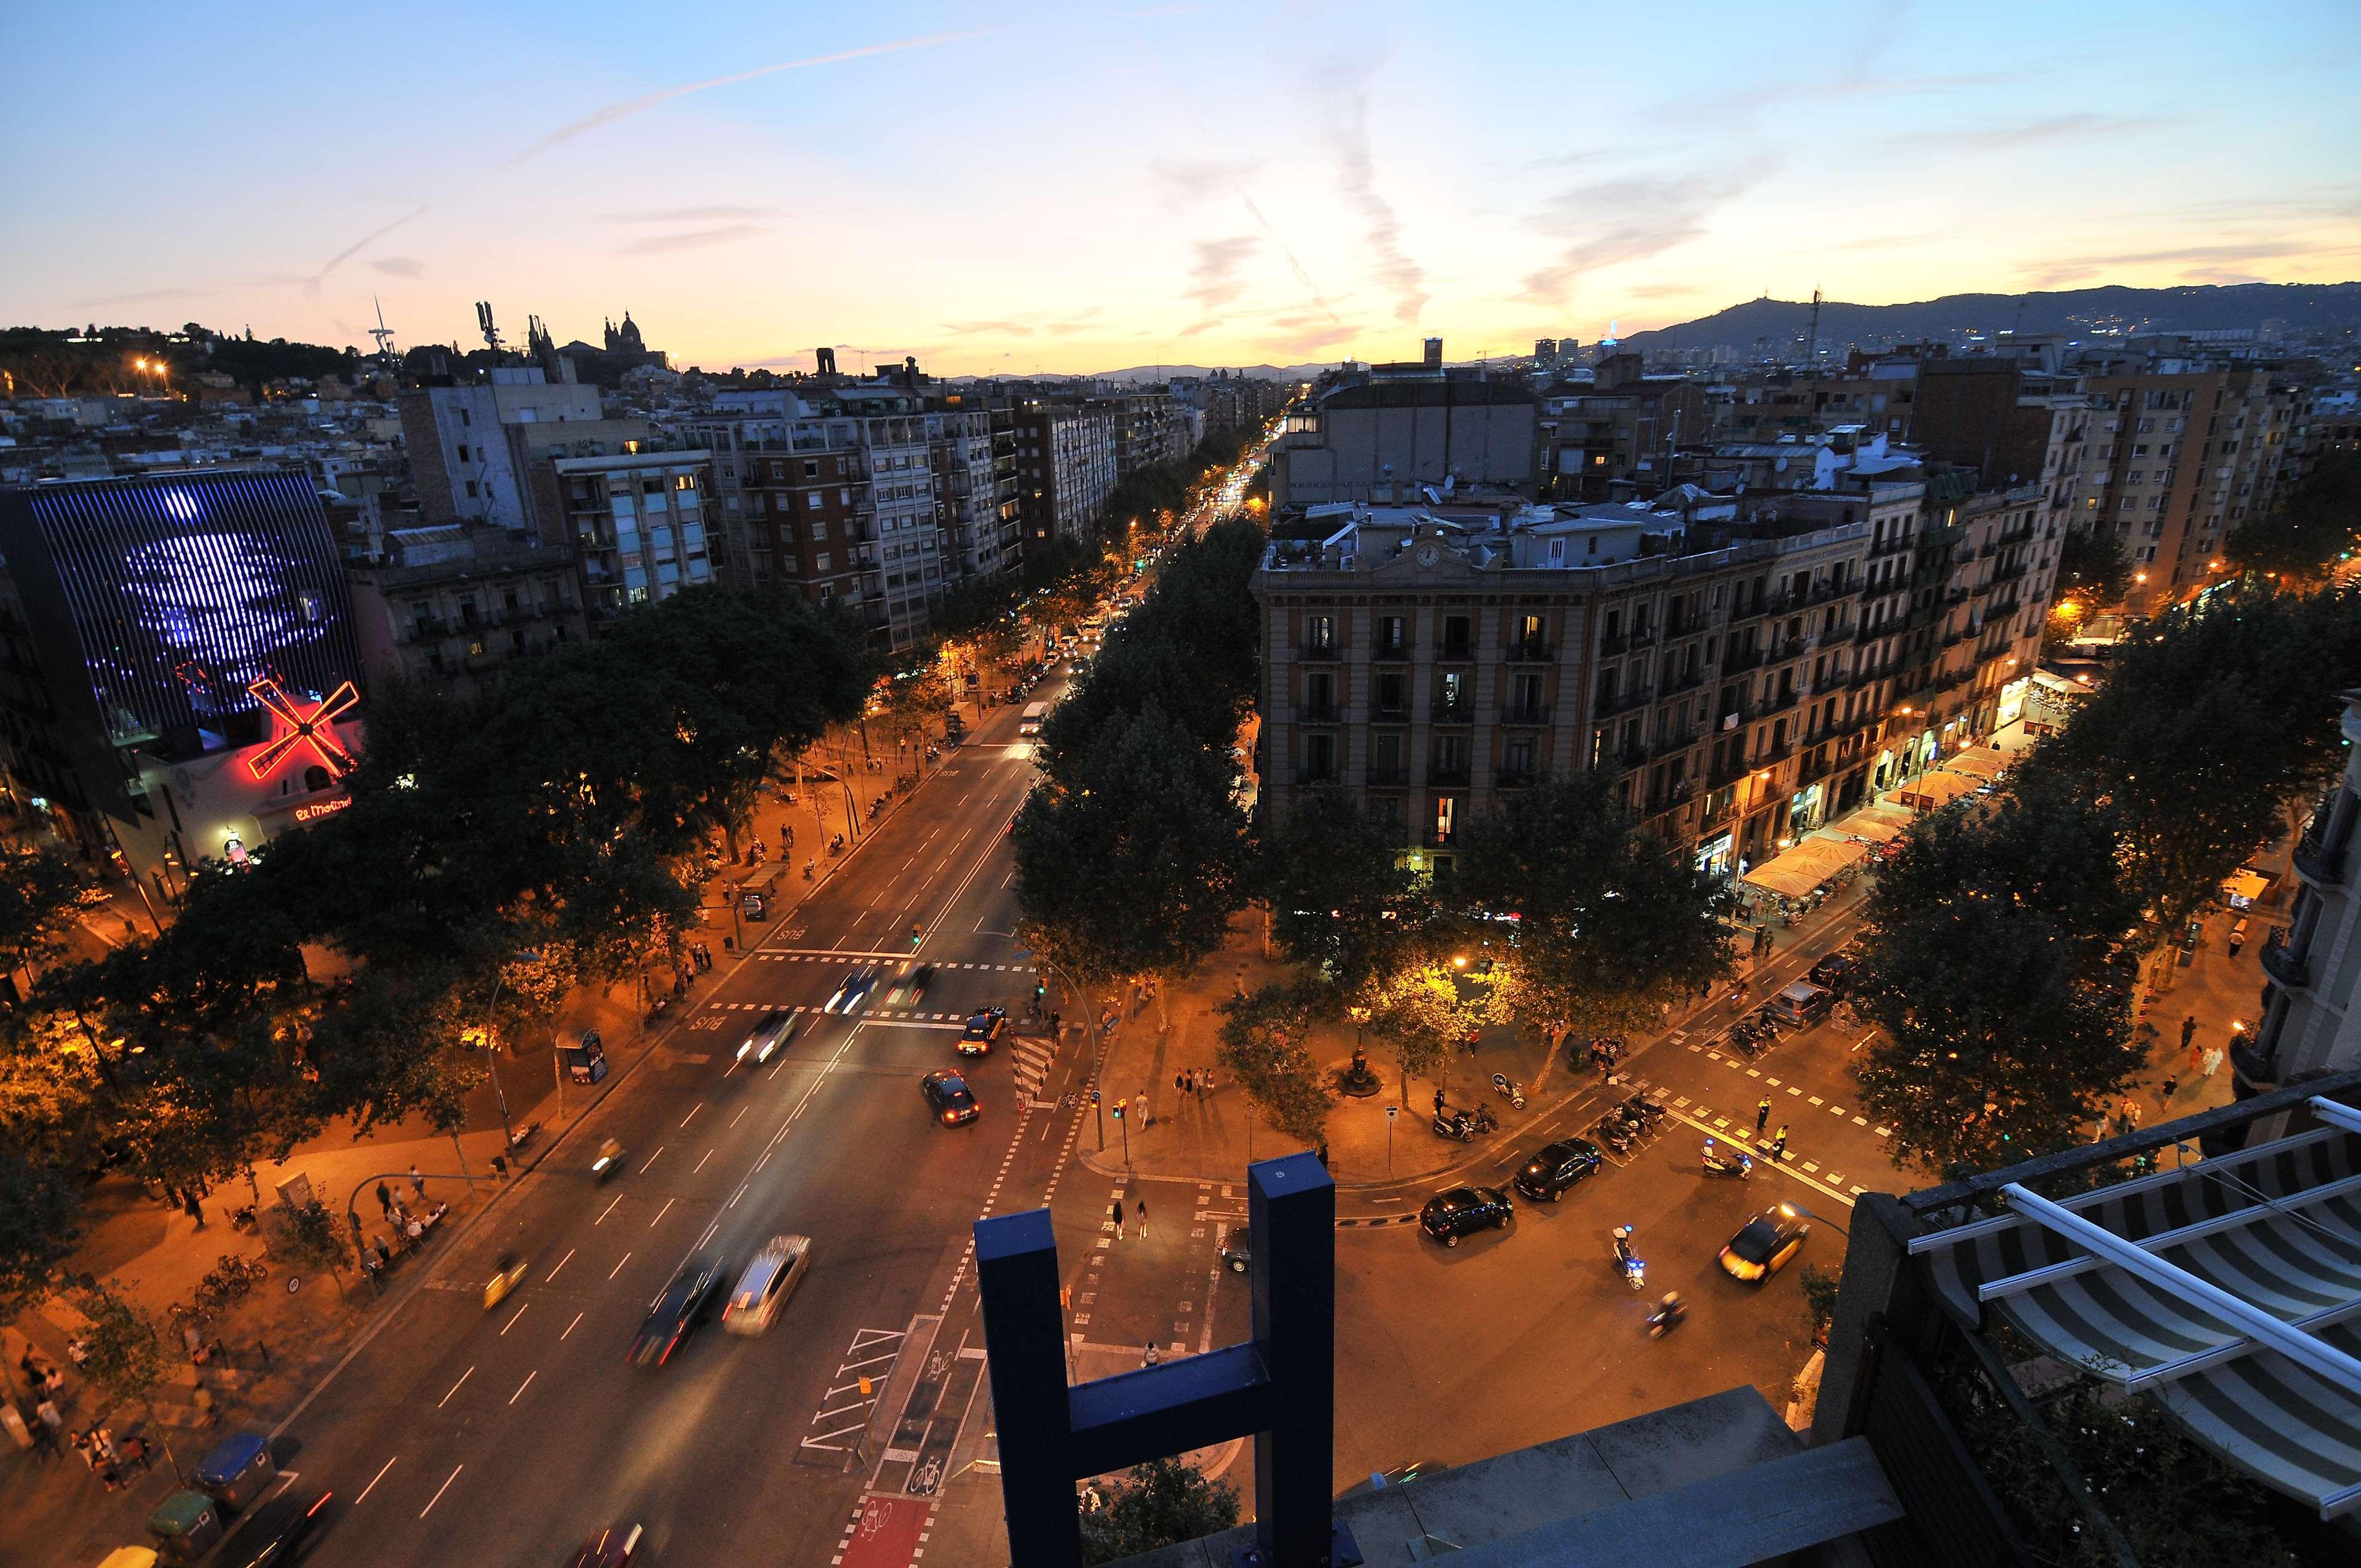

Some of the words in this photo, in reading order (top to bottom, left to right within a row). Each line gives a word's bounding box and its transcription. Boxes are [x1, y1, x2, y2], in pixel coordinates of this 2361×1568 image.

[295, 809, 311, 821] El
[777, 930, 806, 940] BUS
[689, 1016, 727, 1031] BUS
